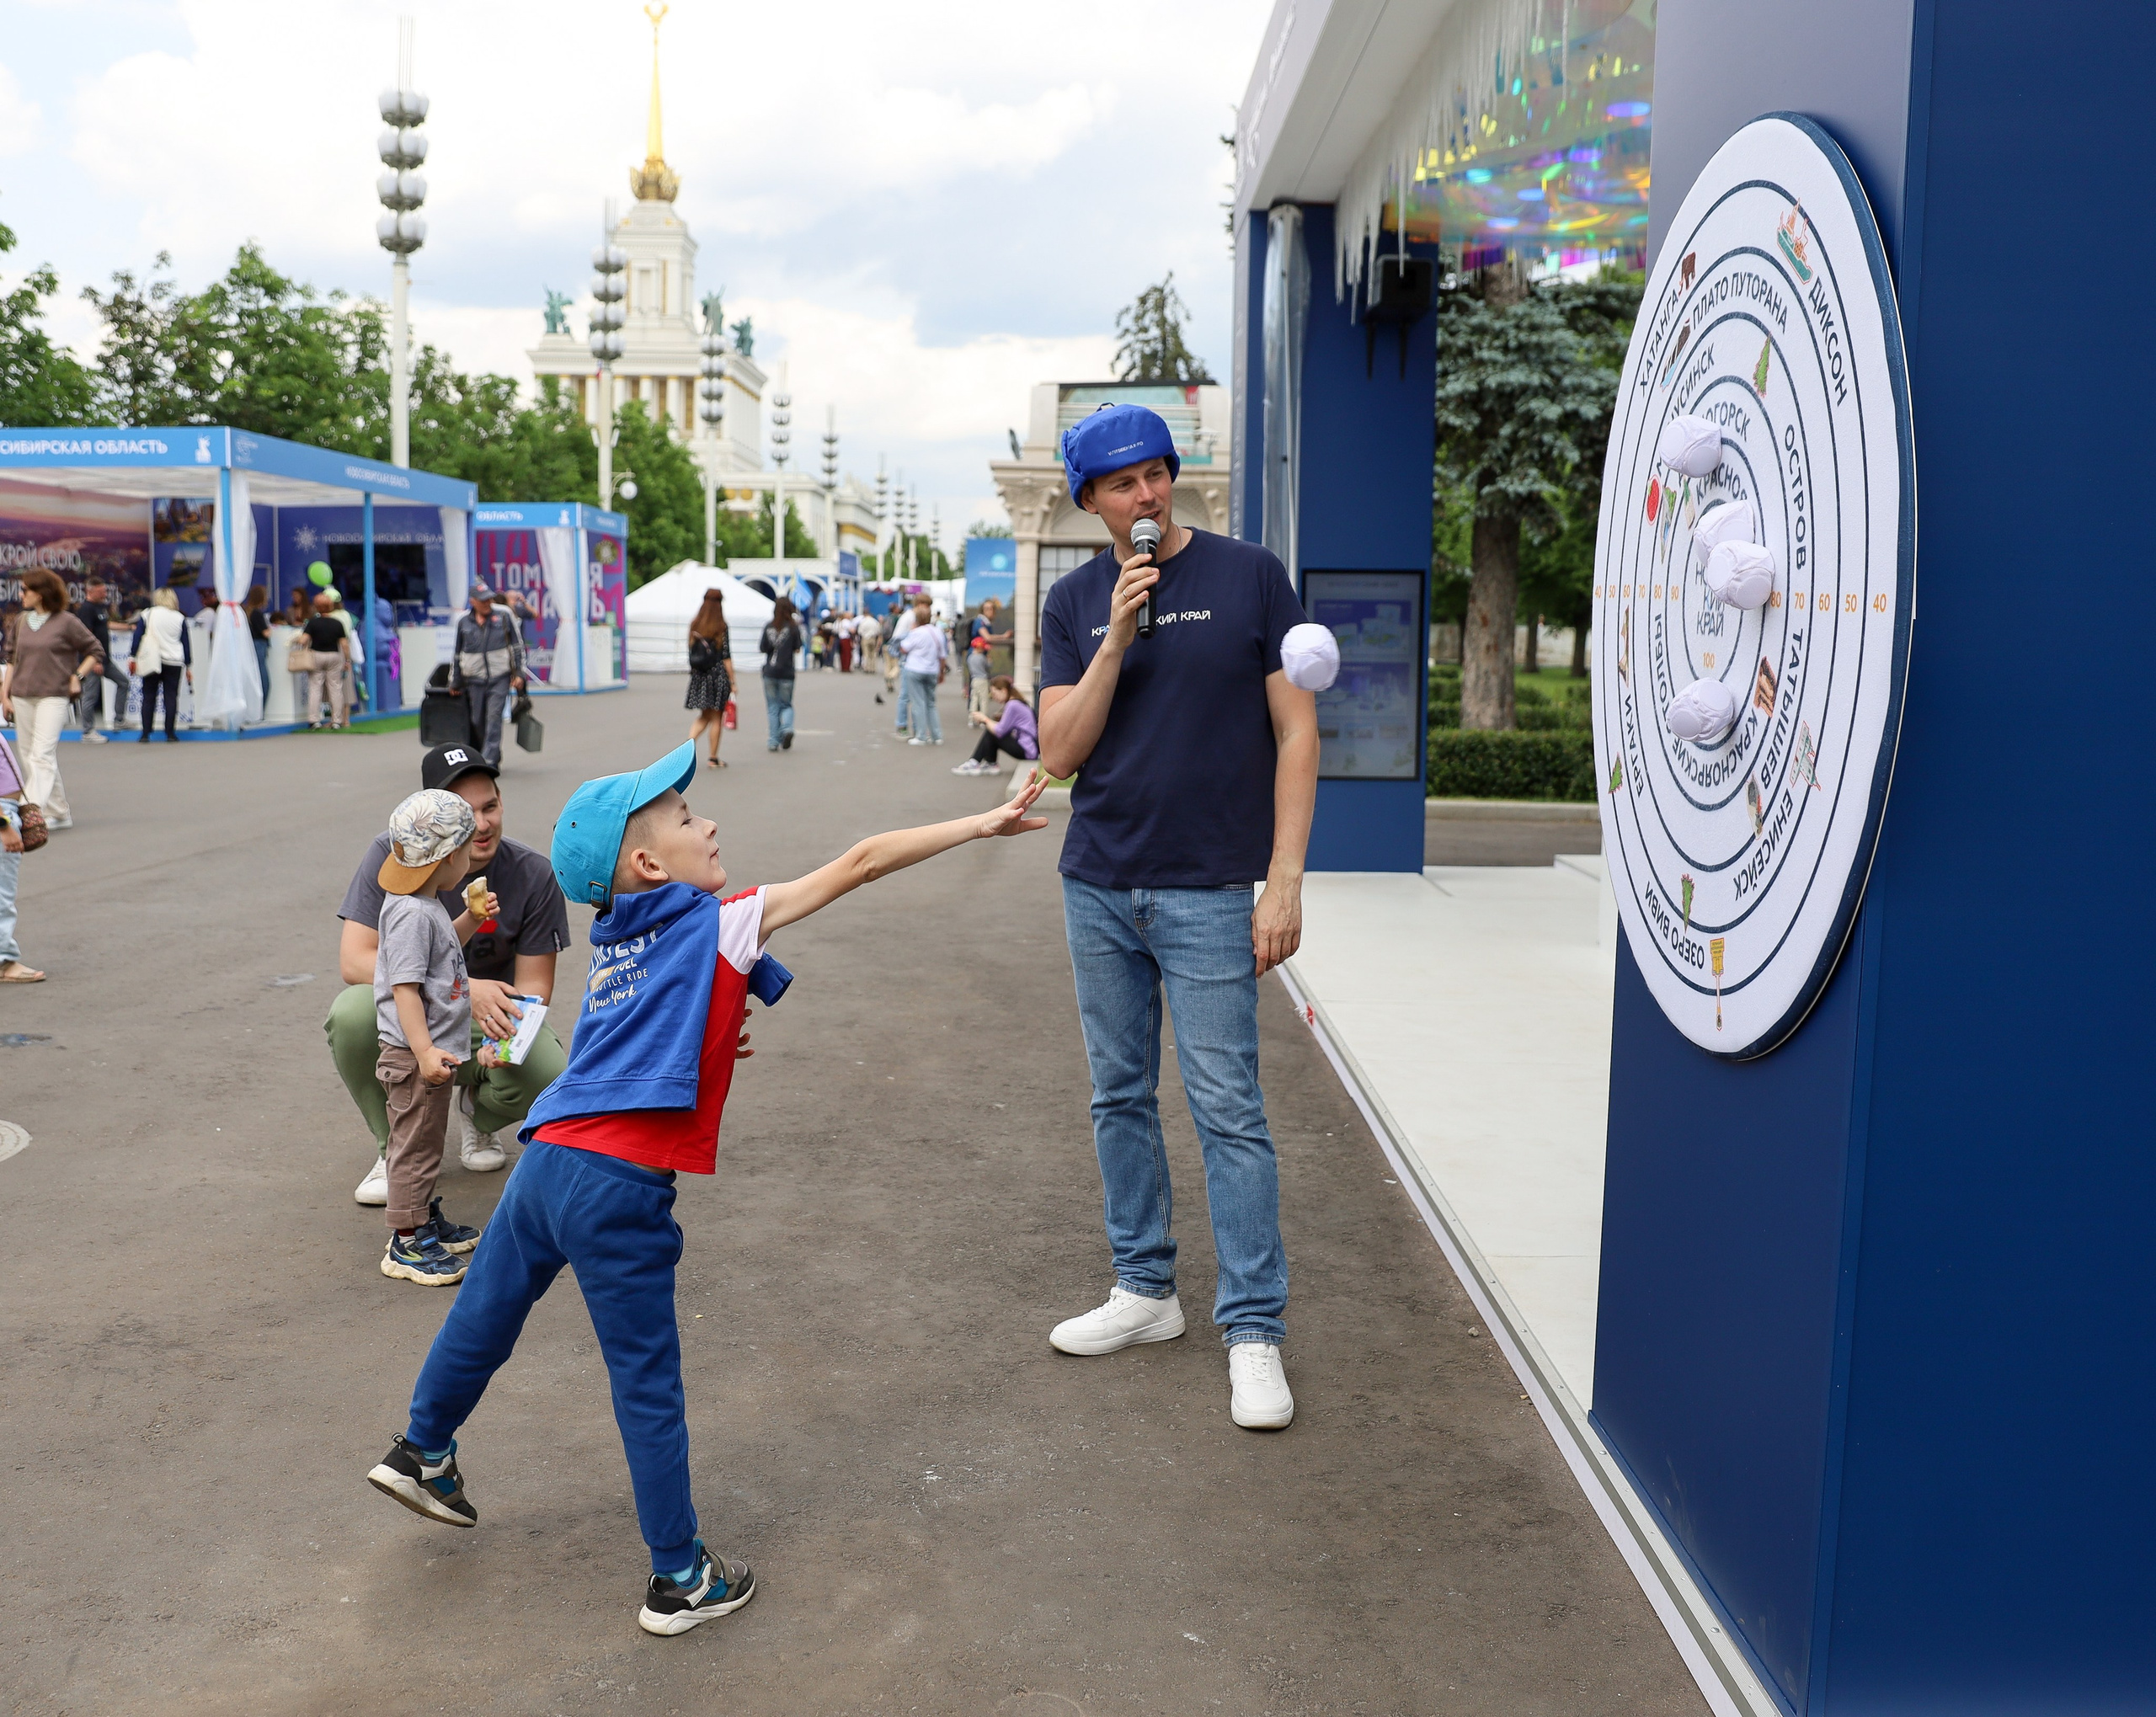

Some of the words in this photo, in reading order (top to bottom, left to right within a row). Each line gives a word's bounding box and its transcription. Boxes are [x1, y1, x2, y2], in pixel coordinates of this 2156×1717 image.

[1692, 276, 1729, 330] ПЛАТО
[1731, 272, 1788, 334] ПУТОРАНА
[1640, 289, 1678, 397] ХАТАНГА
[1809, 275, 1848, 407] ДИКСОН
[0, 439, 92, 456] СИБИРСКАЯ
[93, 438, 168, 455] ОБЛАСТЬ
[1785, 424, 1806, 570] ОСТРОВ
[41, 547, 82, 570] СВОЮ
[490, 562, 605, 589] ТОМЯ
[1594, 584, 1602, 599] 40
[1609, 584, 1616, 599] 50
[1623, 584, 1630, 599] 60
[1639, 584, 1646, 599] 70
[1654, 584, 1662, 600] 80
[1671, 585, 1679, 600] 90
[1771, 591, 1782, 608] 80
[1794, 592, 1805, 610] 70
[1818, 594, 1830, 611] 60
[1844, 594, 1857, 613] 50
[1873, 593, 1887, 613] 40
[1180, 609, 1211, 621] КРАЙ
[1696, 611, 1725, 637] КРАЙ
[1703, 652, 1716, 669] 100
[1760, 628, 1803, 790] ТАТЫШЕВ
[1625, 694, 1644, 798] ЕРГАКИ
[1673, 707, 1758, 787] КРАСНОЯРСКИЕ
[1733, 787, 1794, 901] ЕНИСЕЙСК
[1645, 881, 1670, 941] ВИВИ
[1671, 926, 1705, 969] ОЗЕРО
[613, 957, 638, 974] FUEL
[626, 968, 648, 983] RIDE
[589, 996, 611, 1015] New
[611, 984, 638, 1005] York
